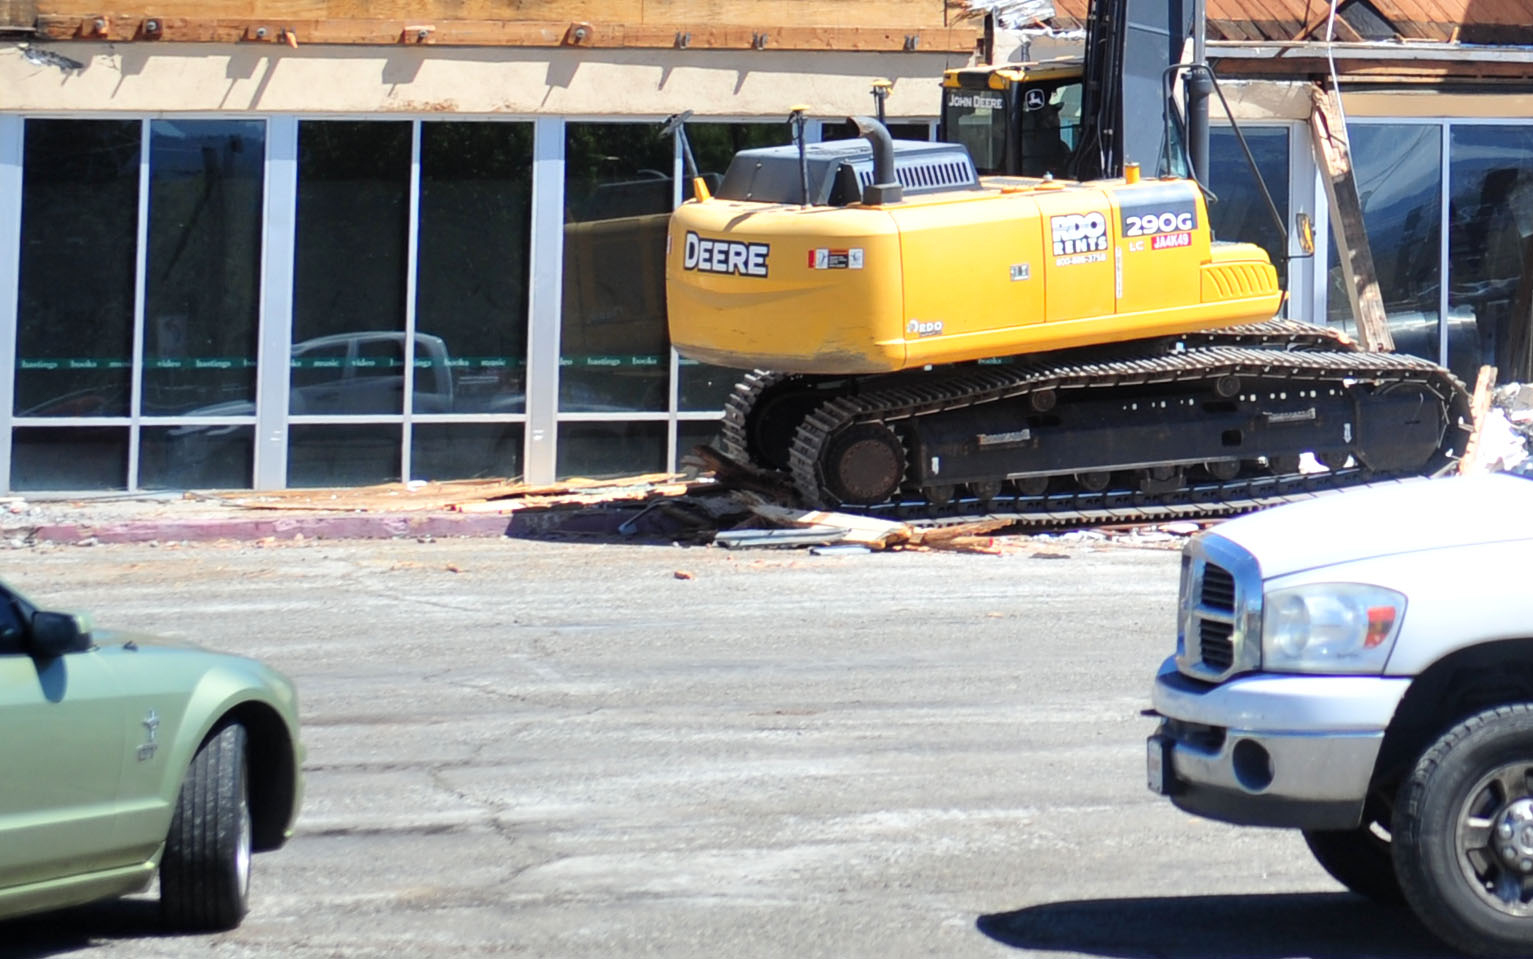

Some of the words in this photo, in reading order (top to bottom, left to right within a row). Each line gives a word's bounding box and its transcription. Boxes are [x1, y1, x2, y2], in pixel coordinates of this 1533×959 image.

[949, 94, 972, 107] JOHN
[973, 95, 1003, 109] DEERE
[1051, 212, 1106, 242] RDO
[1126, 212, 1193, 237] 290G
[684, 233, 770, 276] DEERE
[1053, 236, 1108, 256] RENTS
[1129, 240, 1145, 252] LC
